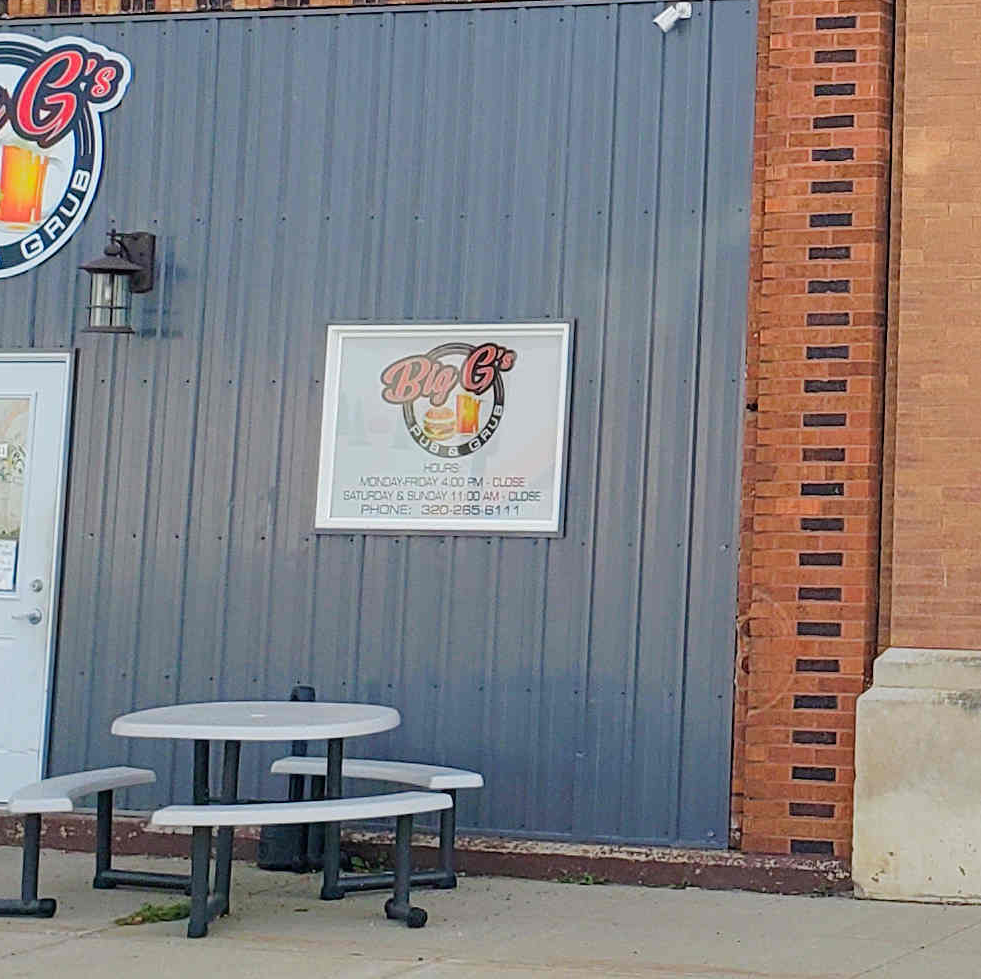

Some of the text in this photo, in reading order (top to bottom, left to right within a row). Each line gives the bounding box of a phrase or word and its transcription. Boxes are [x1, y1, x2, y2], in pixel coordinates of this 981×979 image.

[16, 49, 117, 142] G's
[20, 168, 92, 261] GRUB
[382, 344, 515, 405] Big G's
[410, 424, 440, 454] PUB
[469, 405, 503, 452] GRUB
[343, 490, 395, 501] SATURDAY
[397, 491, 405, 501] &
[407, 490, 447, 501] SUNDAY
[482, 491, 500, 501] AM
[508, 490, 541, 502] CLOSE
[467, 476, 484, 488] PM
[492, 476, 525, 488] CLOSE
[360, 503, 412, 516] PHONE:
